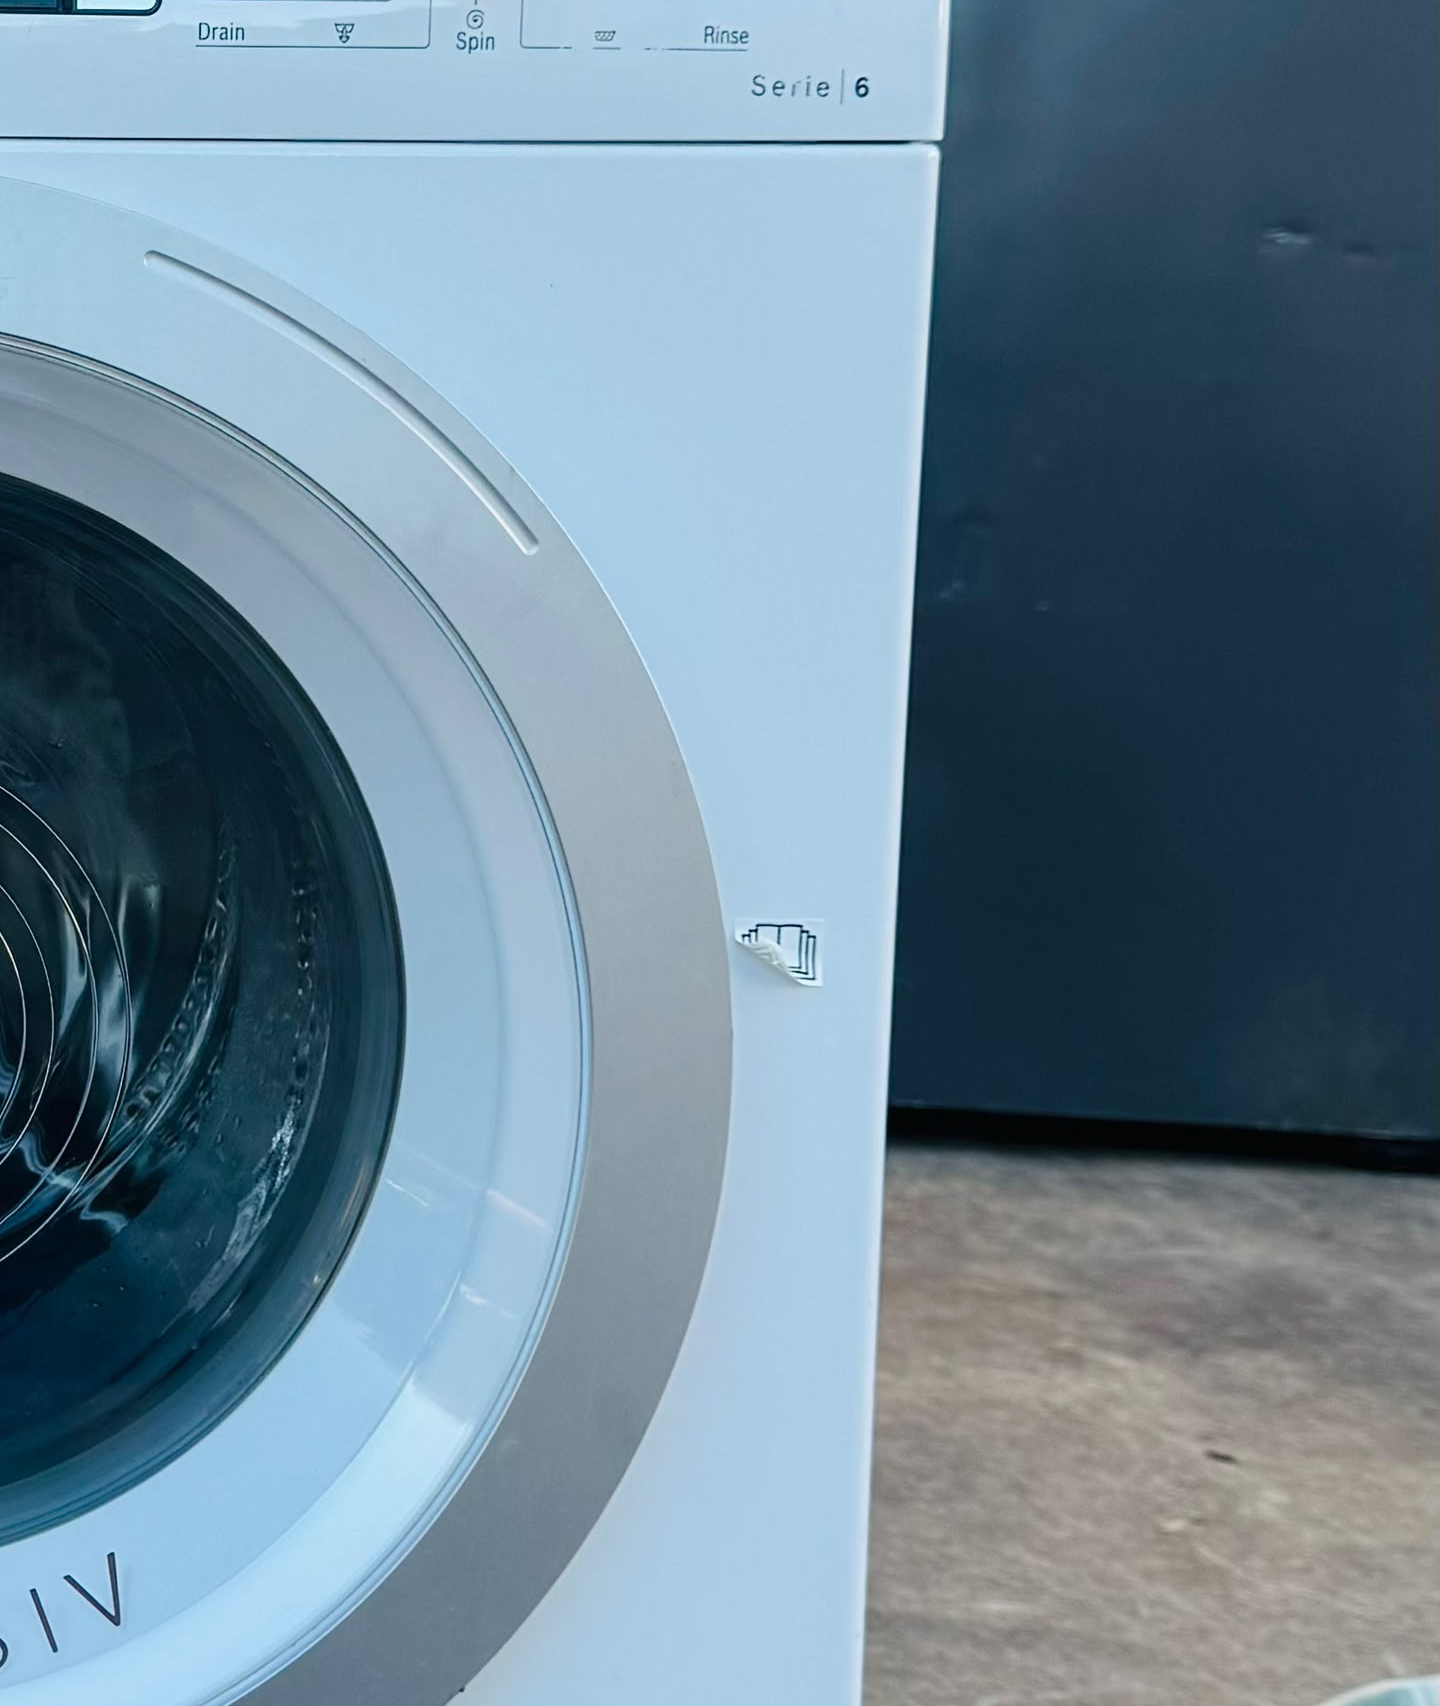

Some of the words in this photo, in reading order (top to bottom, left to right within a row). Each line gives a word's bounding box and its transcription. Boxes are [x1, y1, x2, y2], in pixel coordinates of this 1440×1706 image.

[198, 22, 245, 41] Drain
[704, 25, 749, 45] Rinse
[456, 32, 495, 53] Spin
[751, 74, 830, 98] Serie
[855, 77, 869, 98] 6
